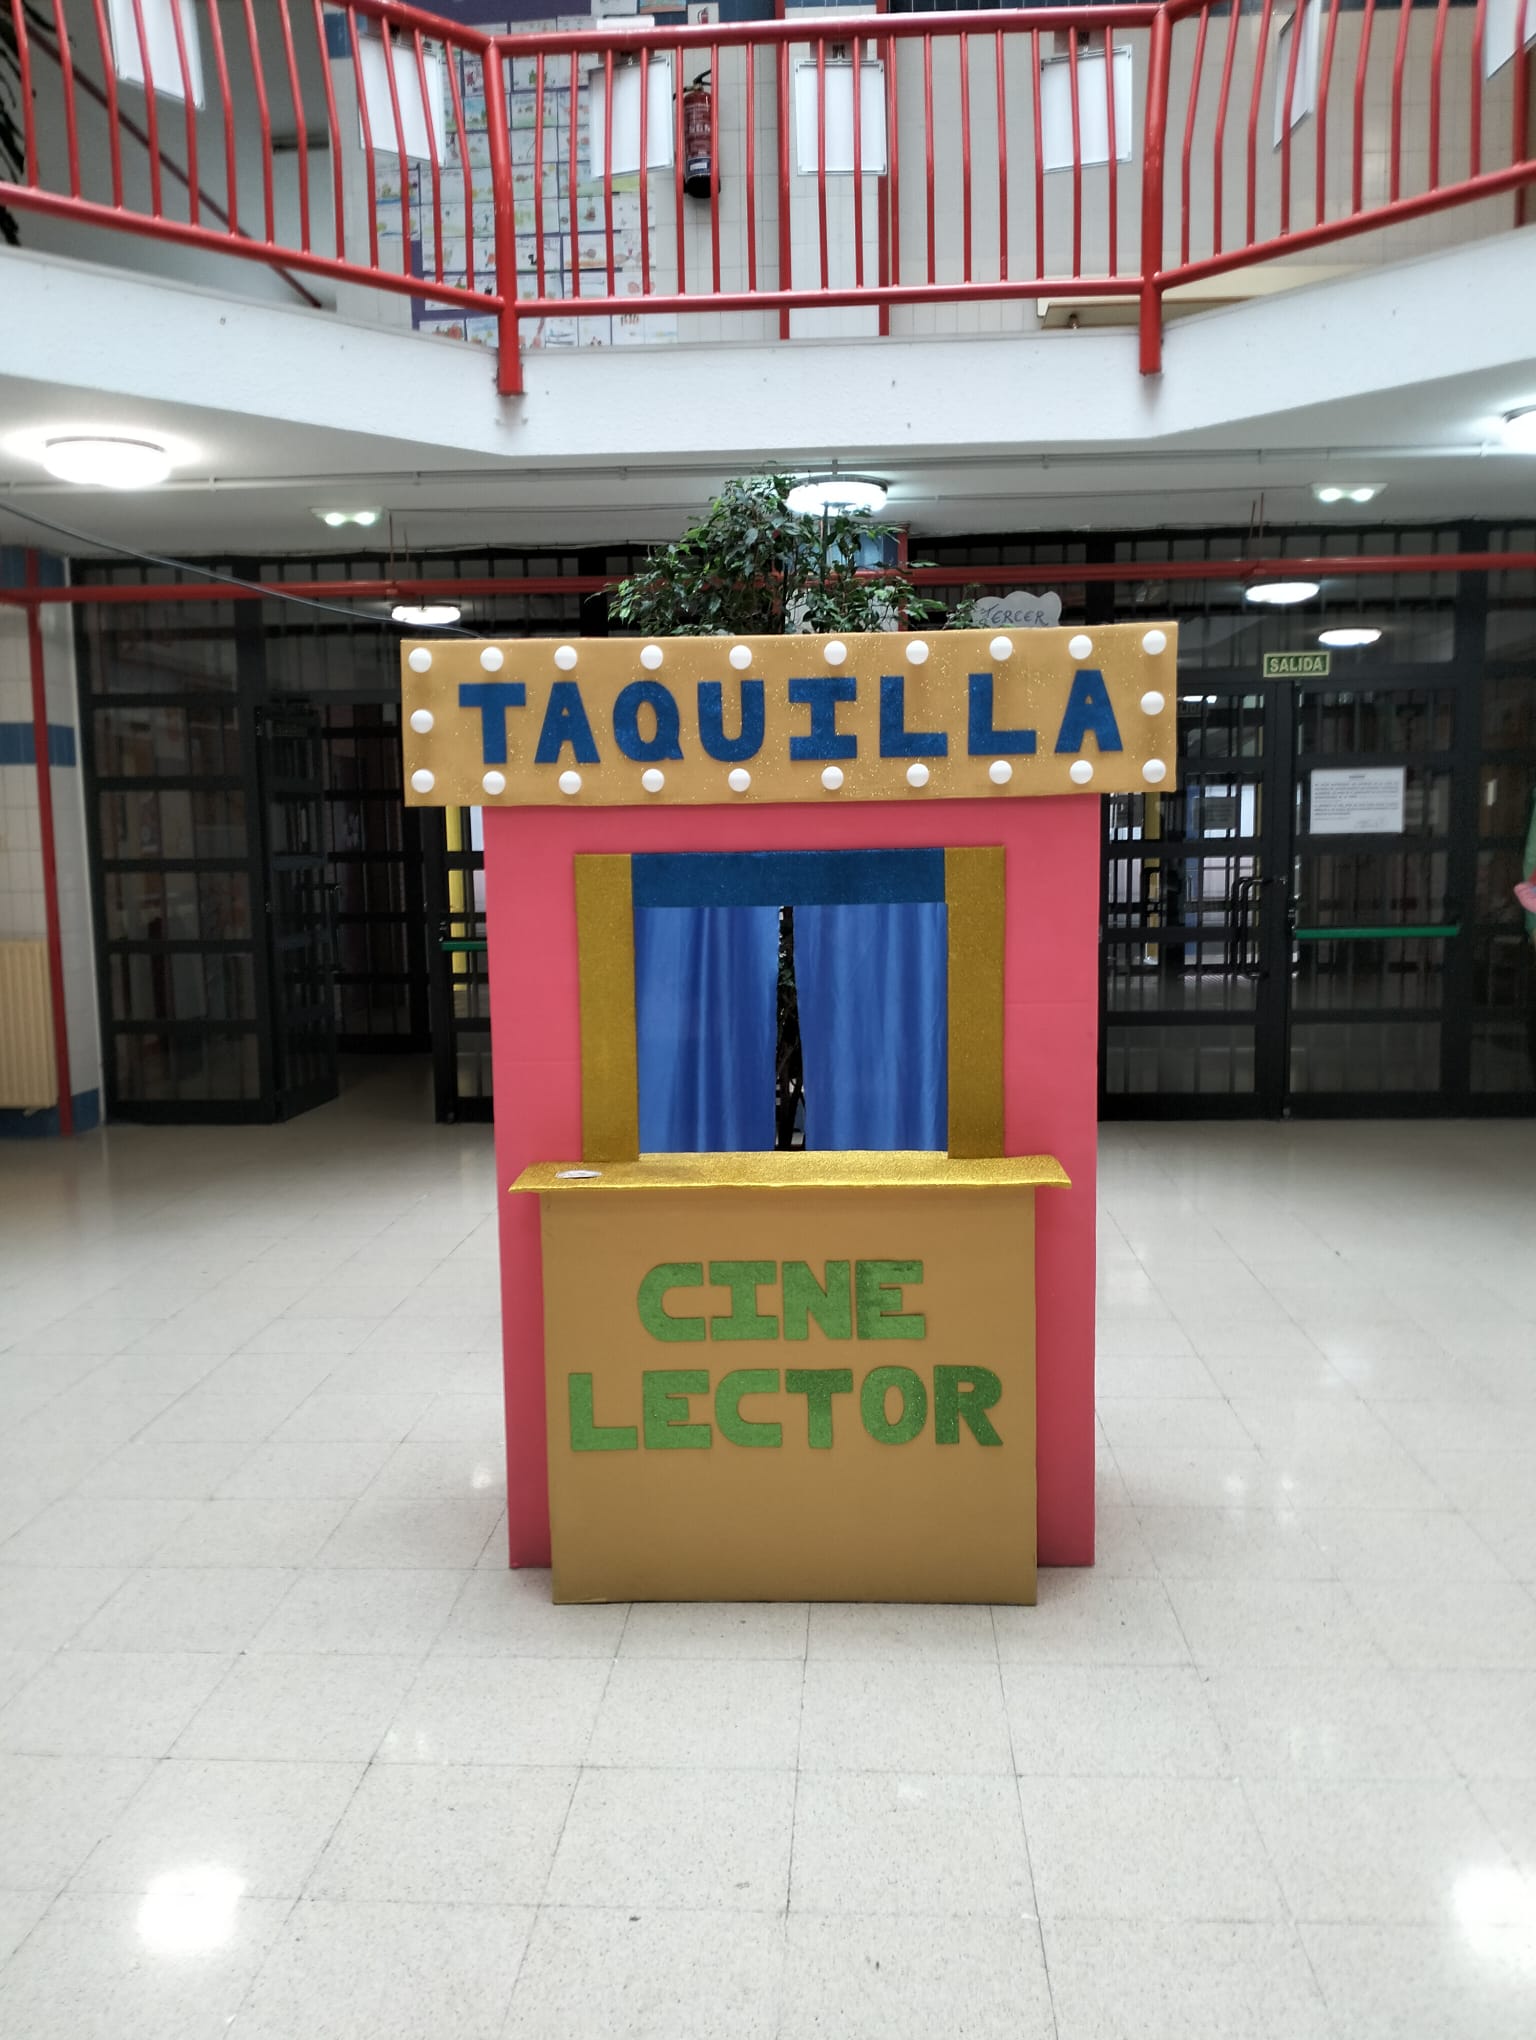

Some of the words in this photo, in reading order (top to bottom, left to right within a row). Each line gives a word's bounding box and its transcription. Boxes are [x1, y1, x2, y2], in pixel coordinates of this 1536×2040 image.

[1270, 656, 1323, 673] SALIDA
[459, 670, 1122, 764] TAQUILLA
[637, 1260, 926, 1342] CINE
[568, 1365, 1003, 1451] LECTOR
